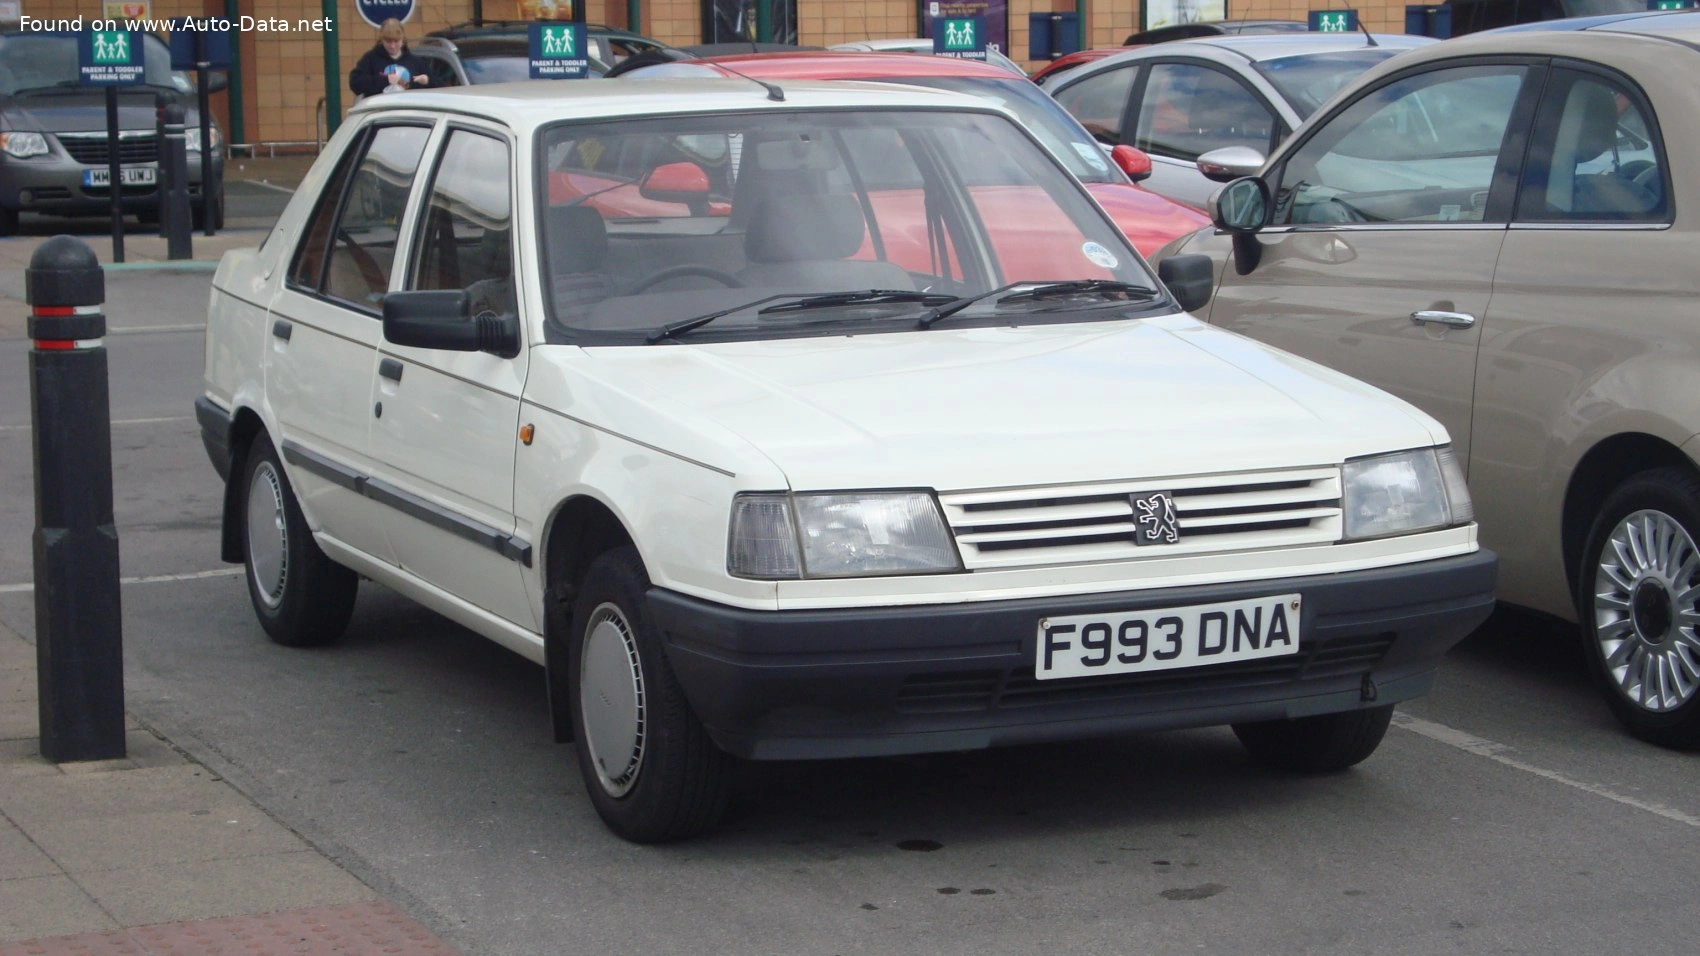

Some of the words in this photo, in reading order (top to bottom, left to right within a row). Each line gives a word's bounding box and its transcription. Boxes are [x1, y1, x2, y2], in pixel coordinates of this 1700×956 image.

[81, 66, 106, 74] PARENT
[93, 170, 126, 182] MM6
[1043, 616, 1184, 671] F993
[1198, 603, 1292, 656] DNA
